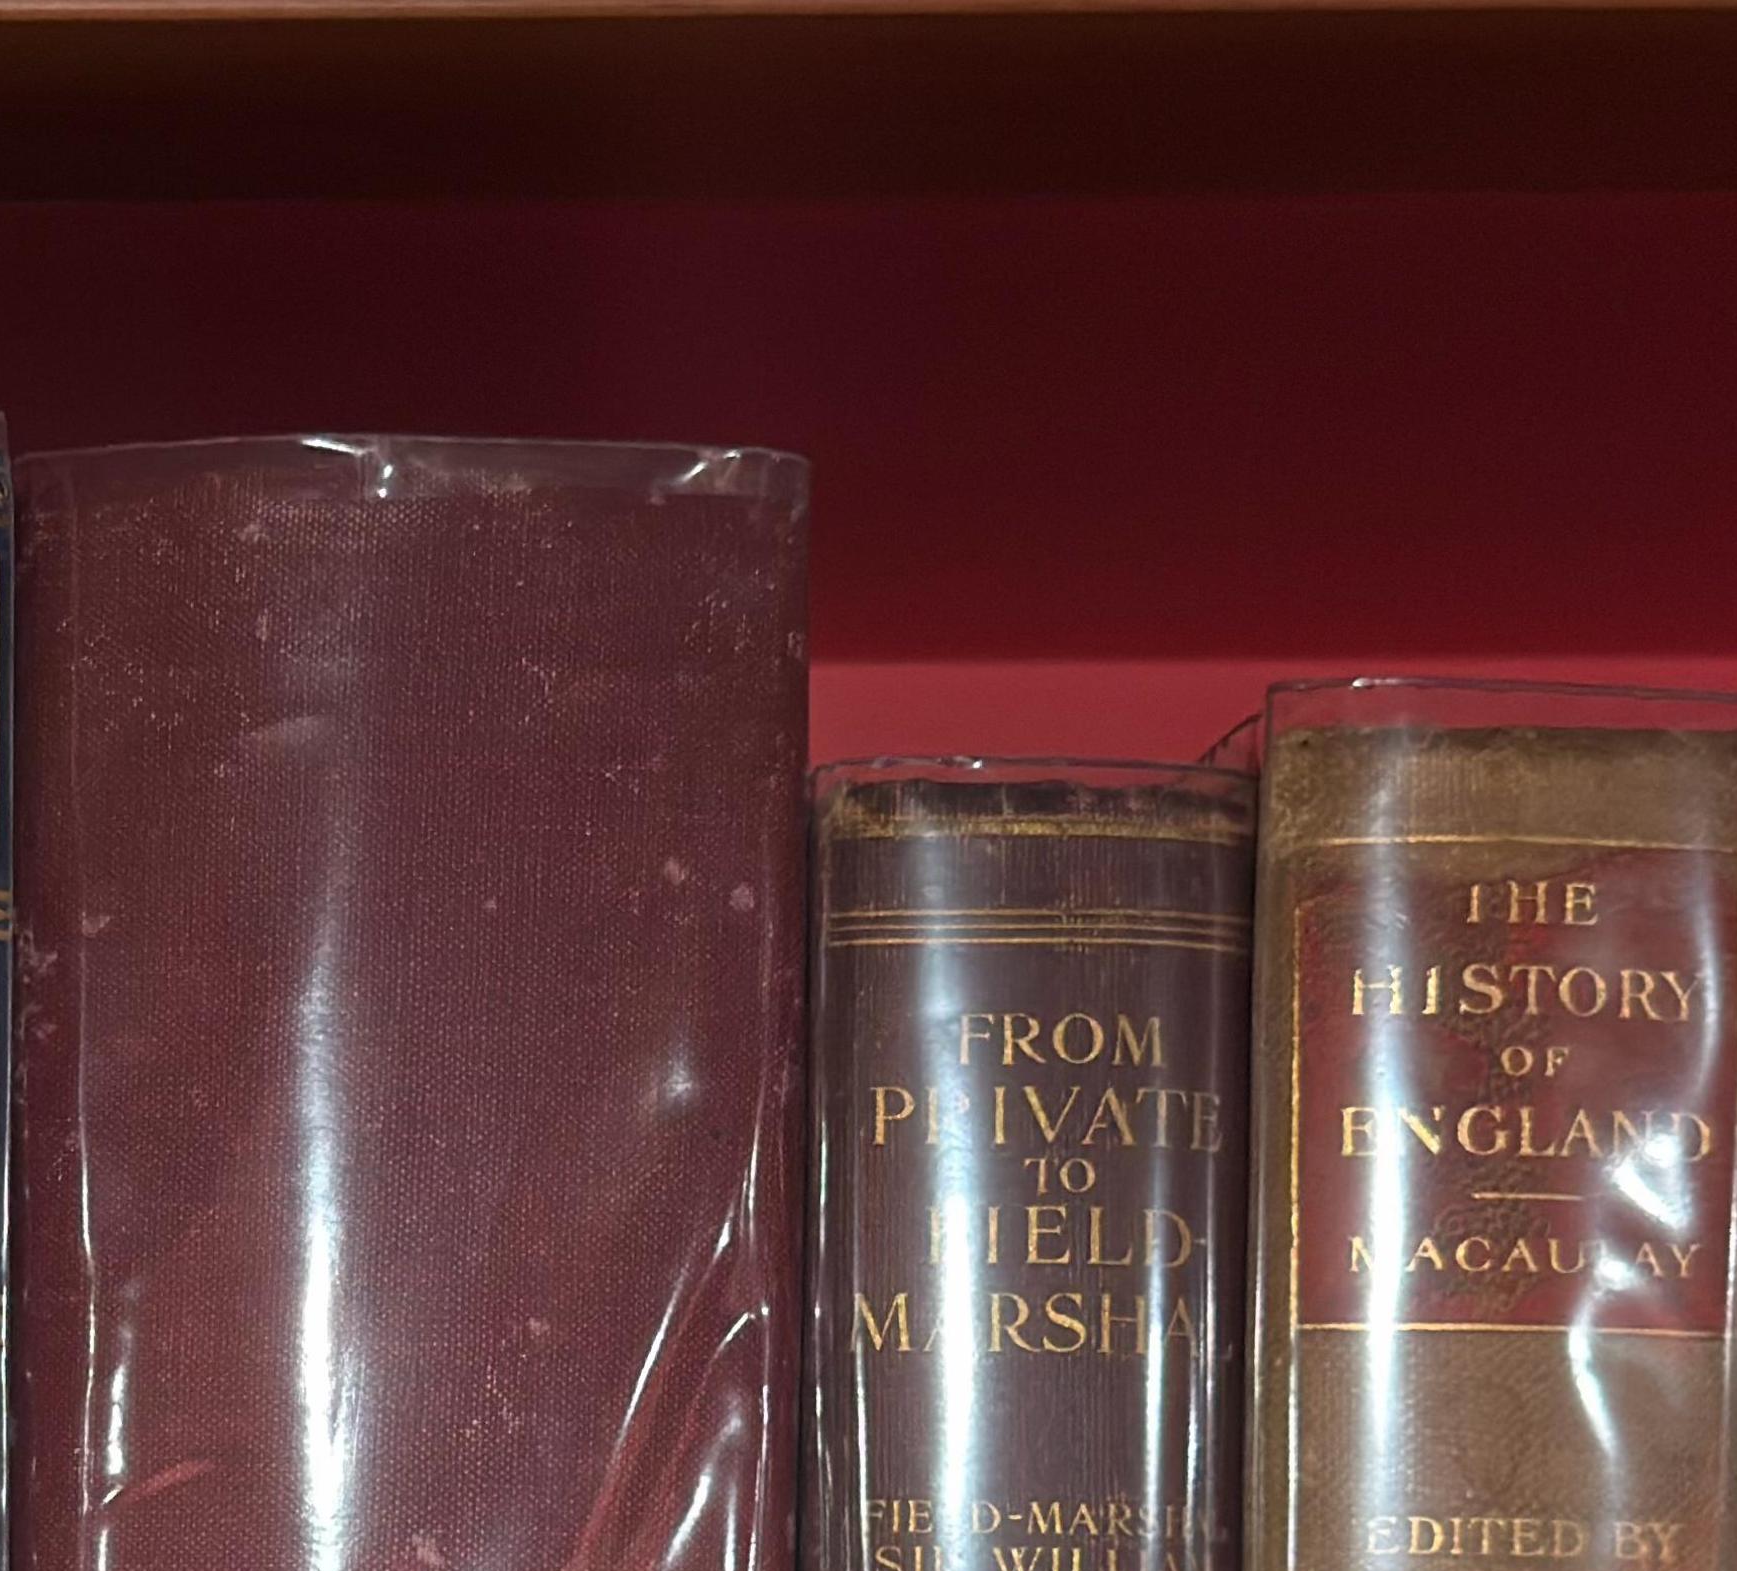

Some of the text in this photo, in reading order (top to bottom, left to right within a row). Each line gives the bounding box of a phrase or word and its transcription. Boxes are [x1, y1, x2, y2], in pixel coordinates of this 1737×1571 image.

[1466, 881, 1599, 926] THE
[1351, 963, 1701, 1022] HISTORY
[959, 1012, 1165, 1067] FROM
[1500, 1046, 1570, 1078] OF
[1341, 1105, 1712, 1159] ENGLAND
[1024, 1157, 1096, 1196] TO
[1349, 1236, 1701, 1279] MACAUAY
[850, 1292, 1233, 1358] MRSHA
[1366, 1515, 1686, 1564] EDITED BY
